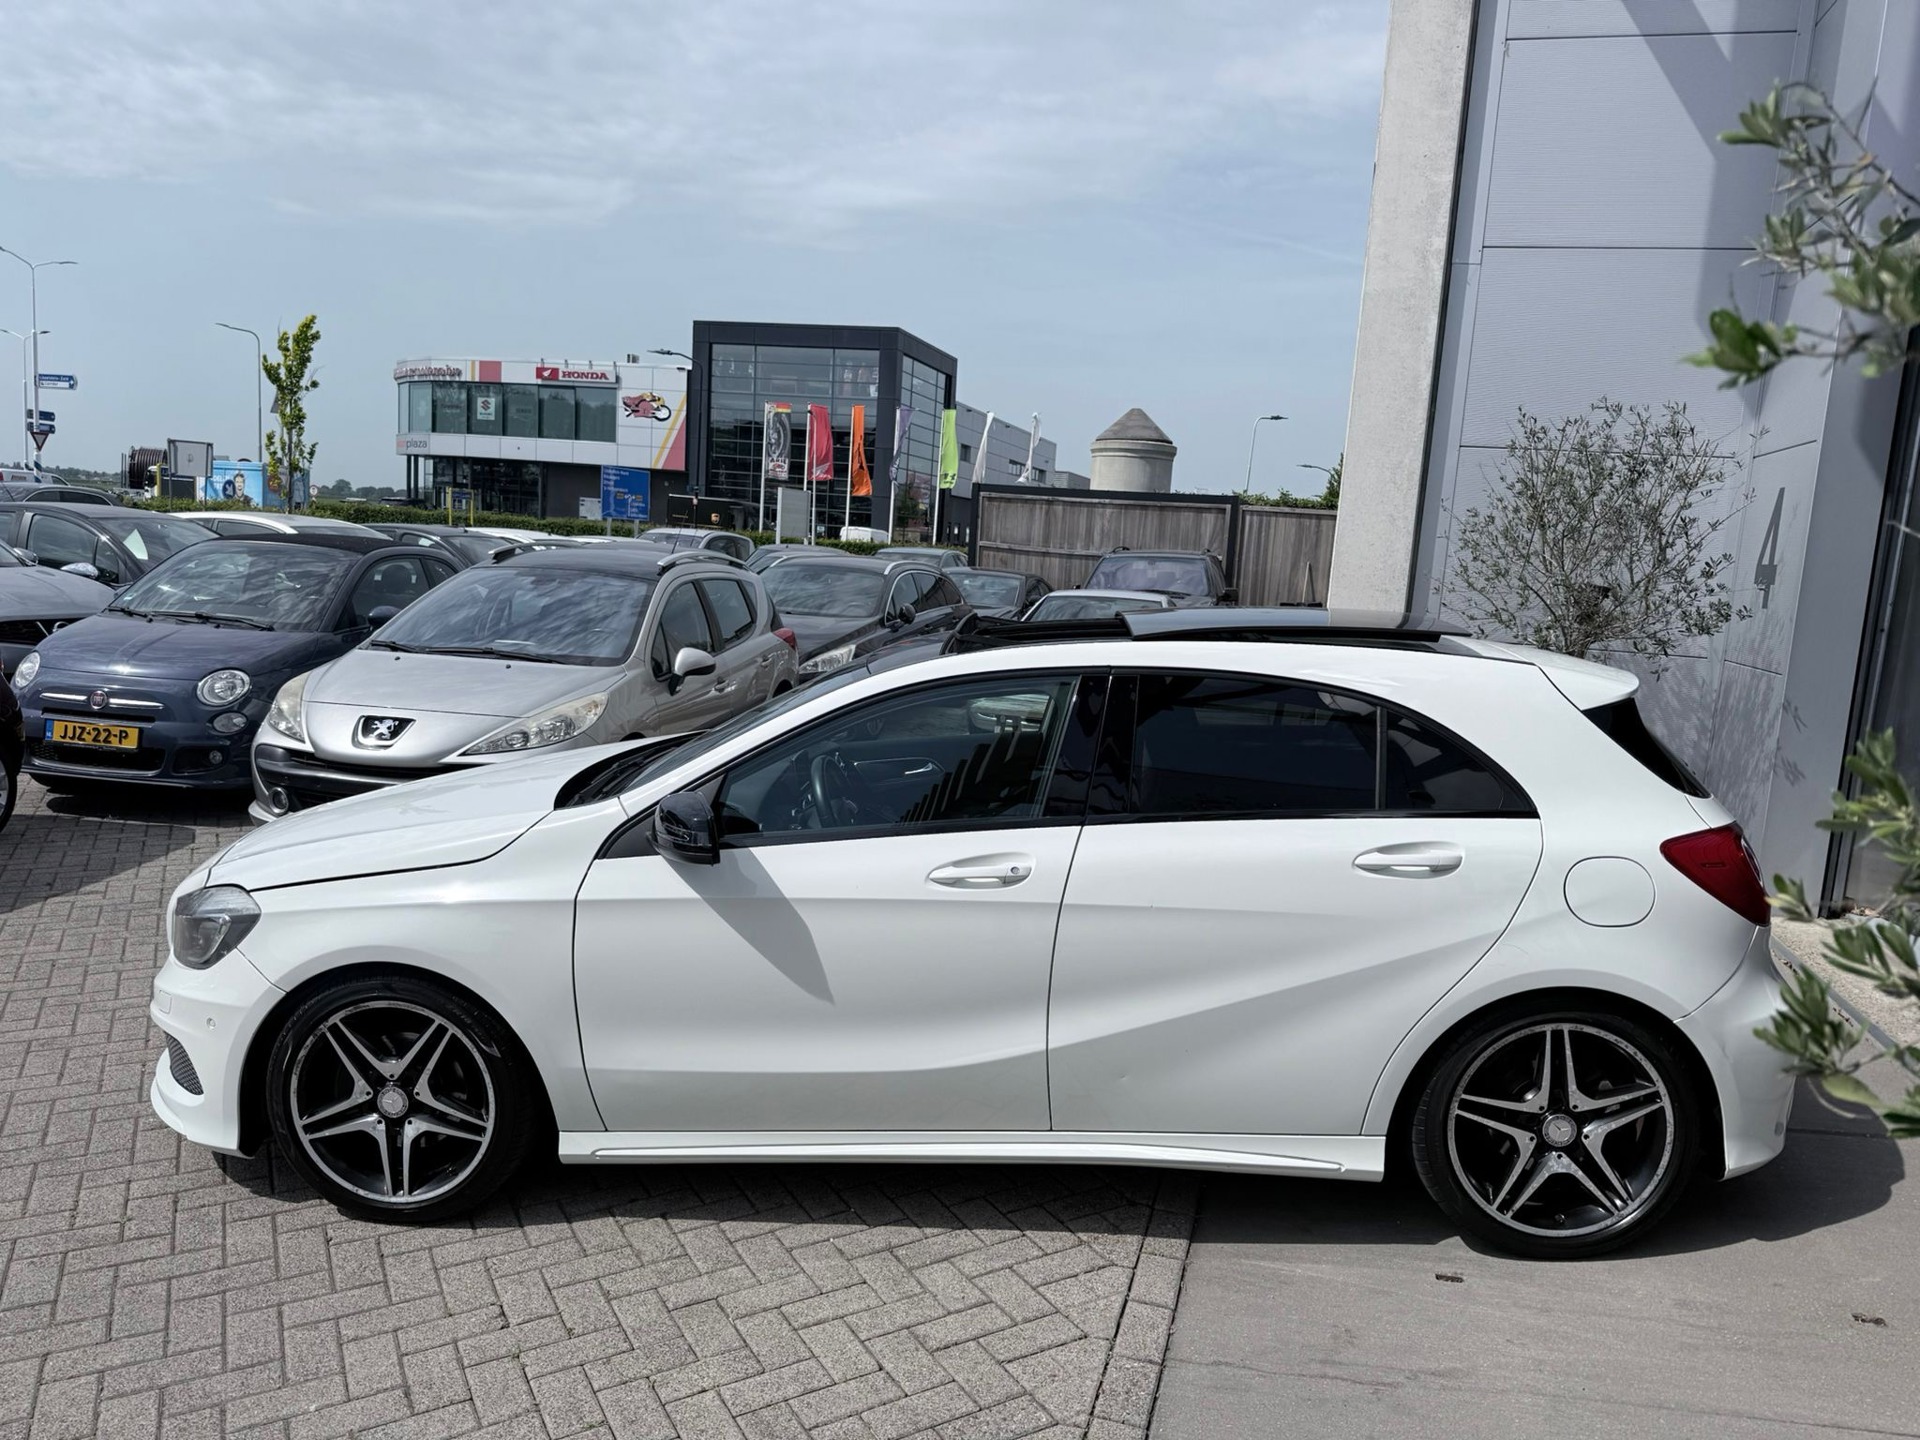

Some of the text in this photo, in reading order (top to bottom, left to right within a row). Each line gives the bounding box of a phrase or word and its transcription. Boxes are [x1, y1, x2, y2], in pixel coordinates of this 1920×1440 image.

[561, 370, 609, 381] HONDA
[1754, 486, 1786, 610] 4
[59, 724, 130, 746] JJZ-22-P
